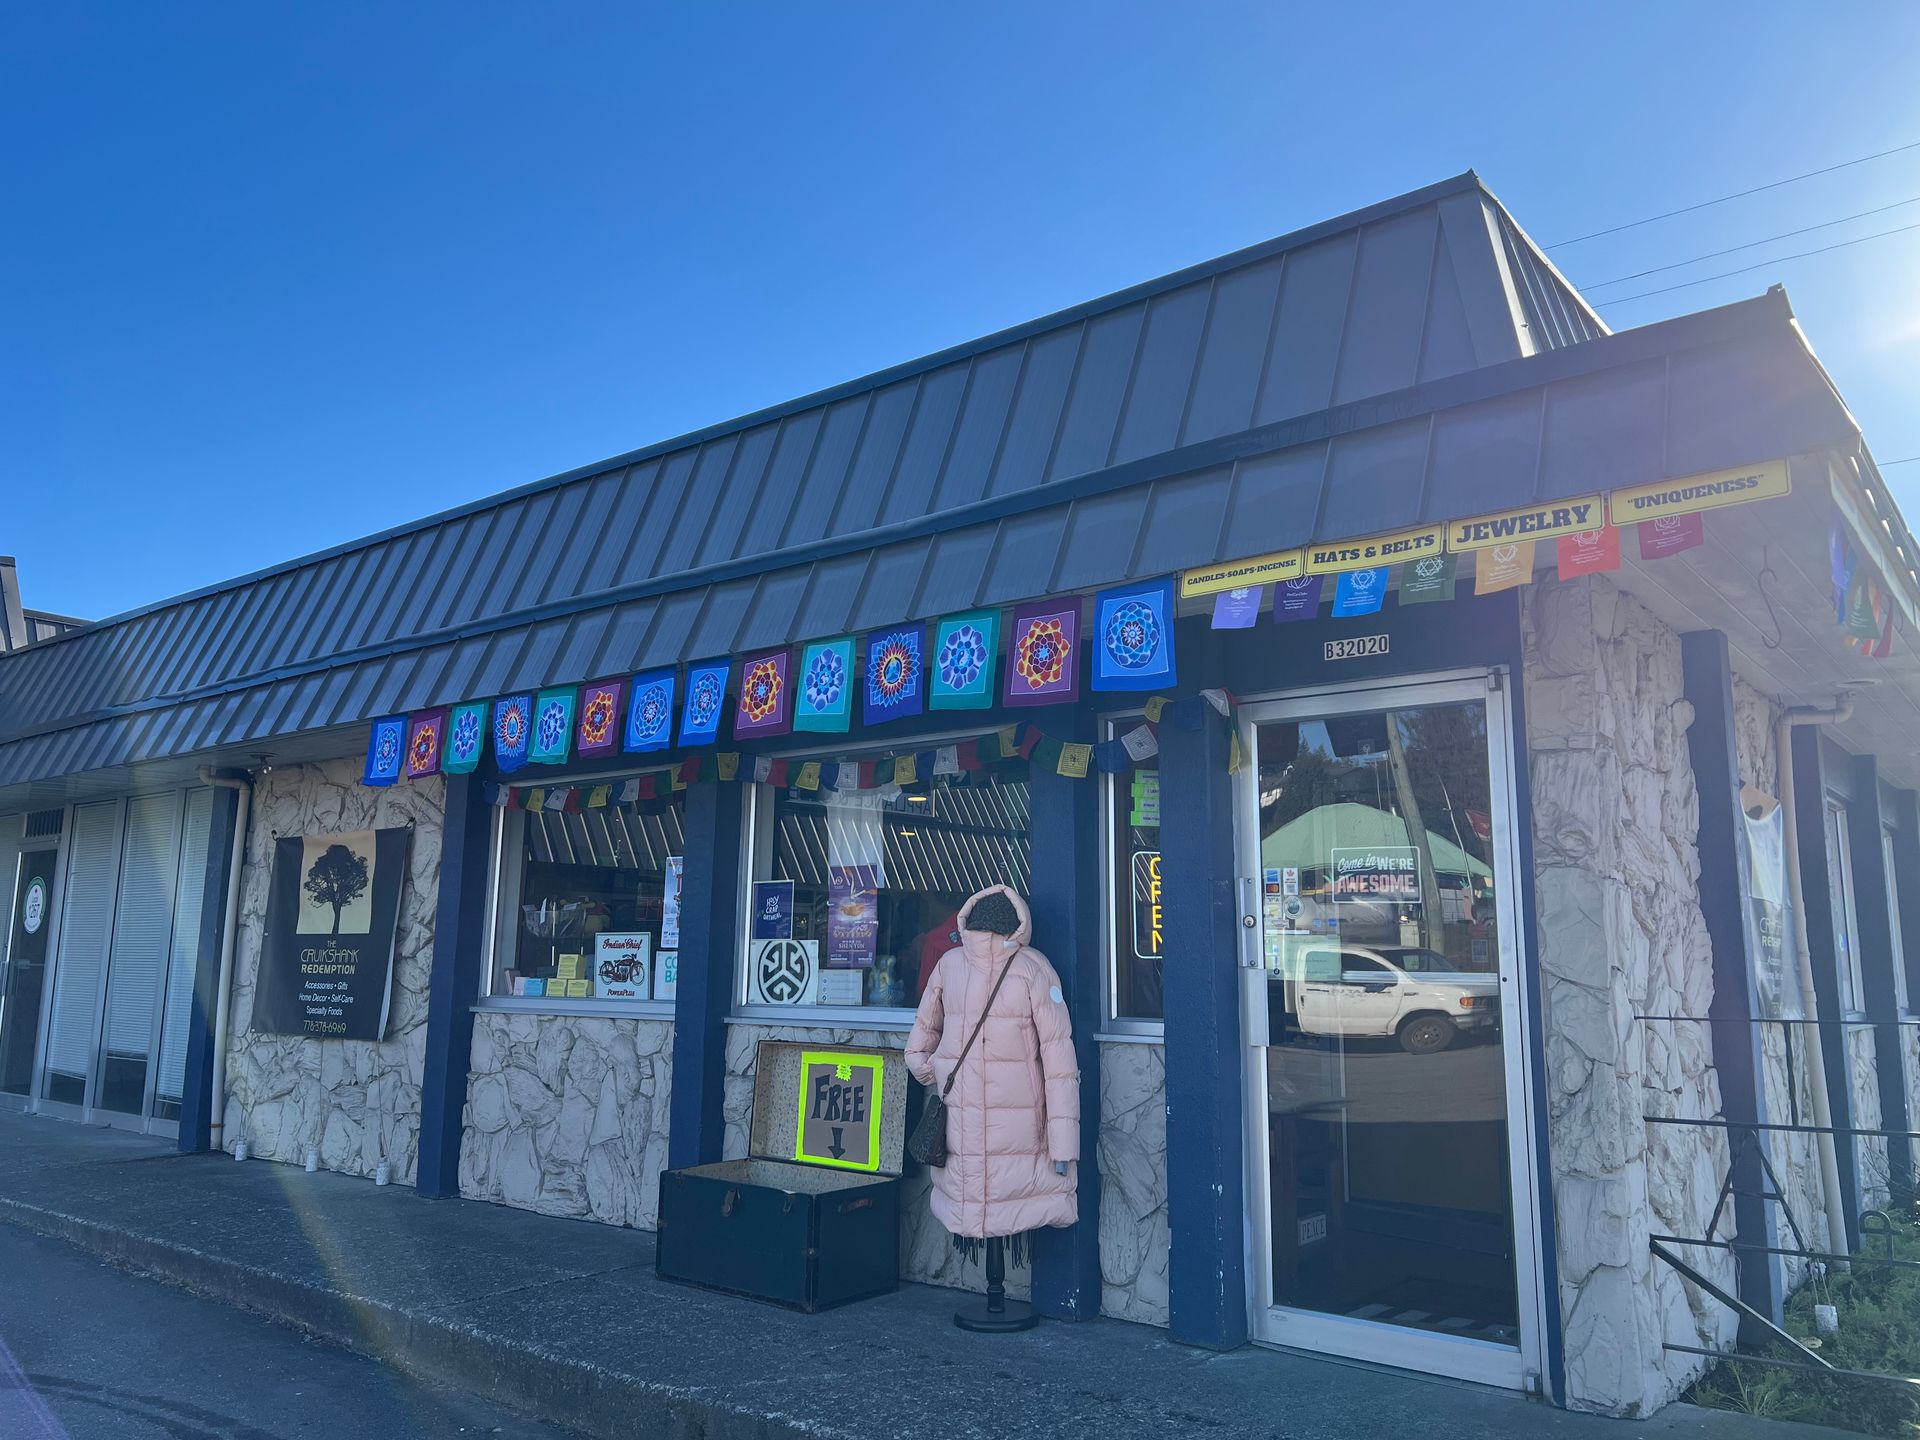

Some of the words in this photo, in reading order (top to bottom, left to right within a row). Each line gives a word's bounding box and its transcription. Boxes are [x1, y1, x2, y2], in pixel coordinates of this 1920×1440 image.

[1457, 504, 1591, 543] JEWELRY
[1313, 549, 1360, 565] HATS
[1365, 546, 1376, 558] &
[1381, 534, 1435, 556] BELTS
[1326, 636, 1388, 659] B32020
[1337, 858, 1364, 871] Come
[1365, 854, 1377, 867] in
[1376, 857, 1415, 870] WE'RE
[1338, 875, 1416, 893] AWESOME
[327, 940, 337, 948] THE
[300, 948, 360, 963] CRUIKSHANK
[301, 964, 356, 975] REDEMPTION
[312, 993, 328, 1002] Decor
[306, 1005, 328, 1016] Specialty
[327, 1006, 343, 1016] Foods
[811, 1074, 865, 1123] FREE
